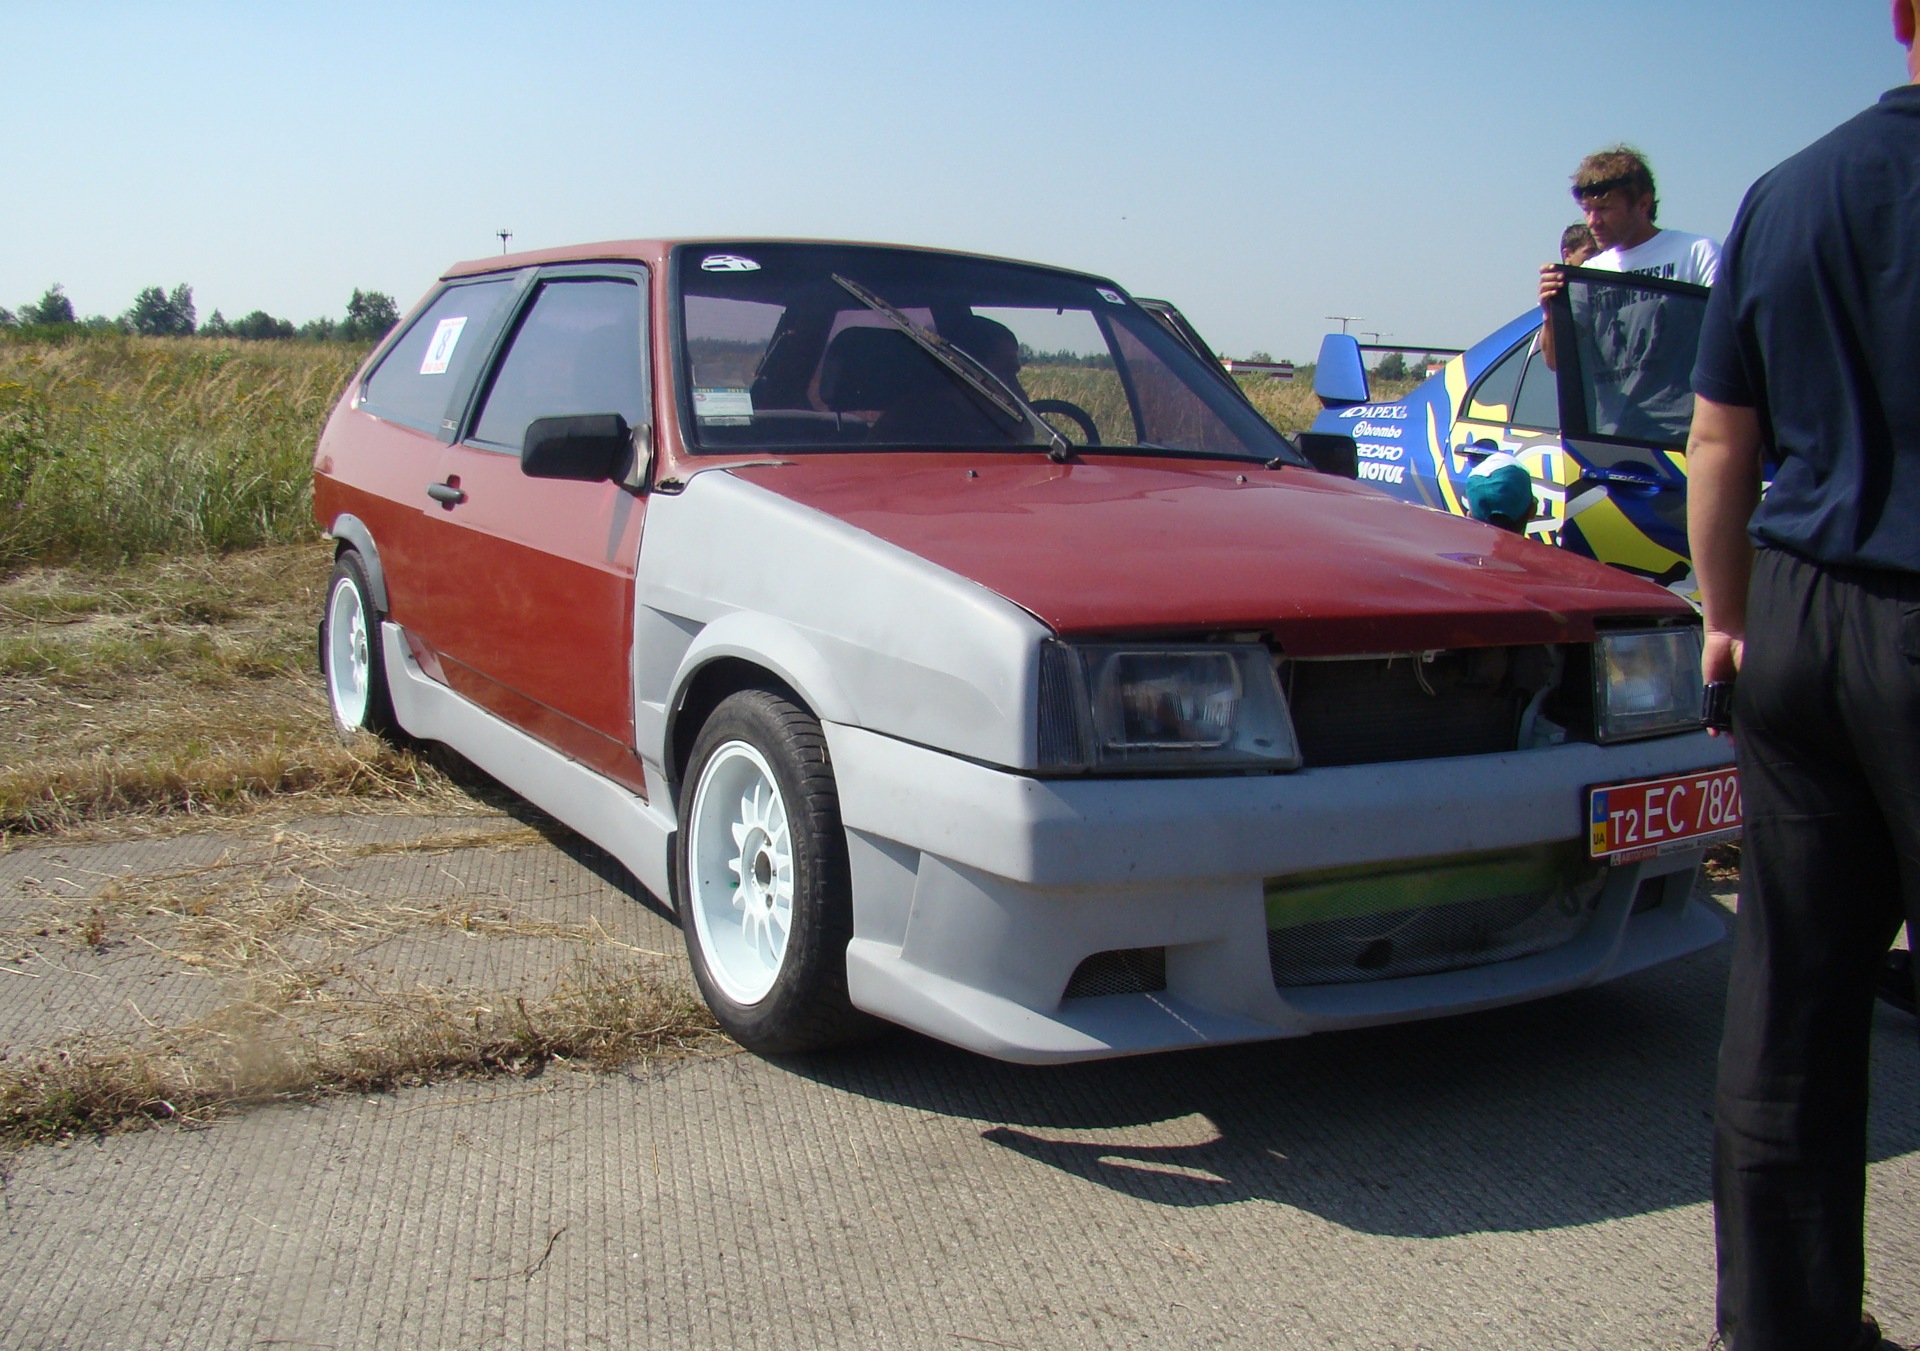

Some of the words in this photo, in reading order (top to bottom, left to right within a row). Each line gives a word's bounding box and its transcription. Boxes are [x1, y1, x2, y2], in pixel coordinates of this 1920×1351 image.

[1662, 262, 1675, 279] IN
[1363, 424, 1402, 438] brembo
[1358, 462, 1405, 484] MOTUL
[1593, 831, 1606, 846] UA
